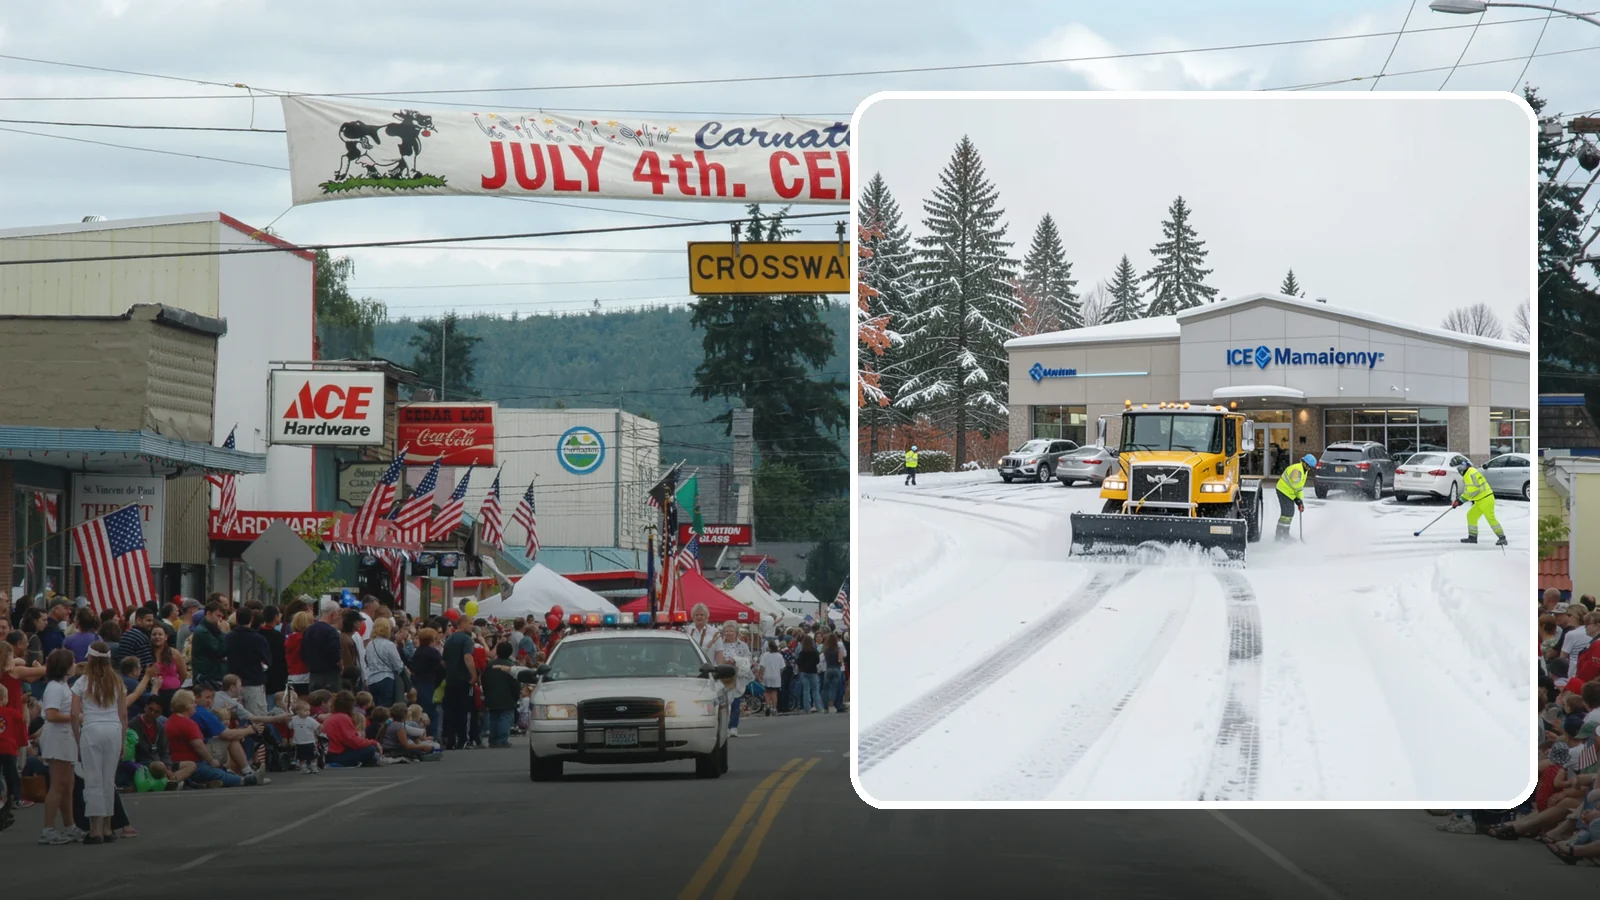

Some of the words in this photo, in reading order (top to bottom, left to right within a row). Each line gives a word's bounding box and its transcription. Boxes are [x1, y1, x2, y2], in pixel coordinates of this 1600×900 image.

[694, 121, 850, 150] Carnat
[481, 141, 605, 192] JULY
[632, 151, 747, 197] 4th.
[697, 254, 850, 280] CROSSWA
[1226, 349, 1253, 366] ICE
[283, 380, 373, 420] ACE
[406, 410, 452, 421] CEDAR
[461, 409, 485, 421] LOG
[283, 421, 370, 436] Hardware
[416, 428, 477, 447] Coca-Cola
[95, 485, 124, 495] Vincent
[126, 486, 136, 495] de
[137, 485, 155, 495] Paul
[688, 526, 741, 535] CRNATION
[699, 535, 729, 543] GLASS
